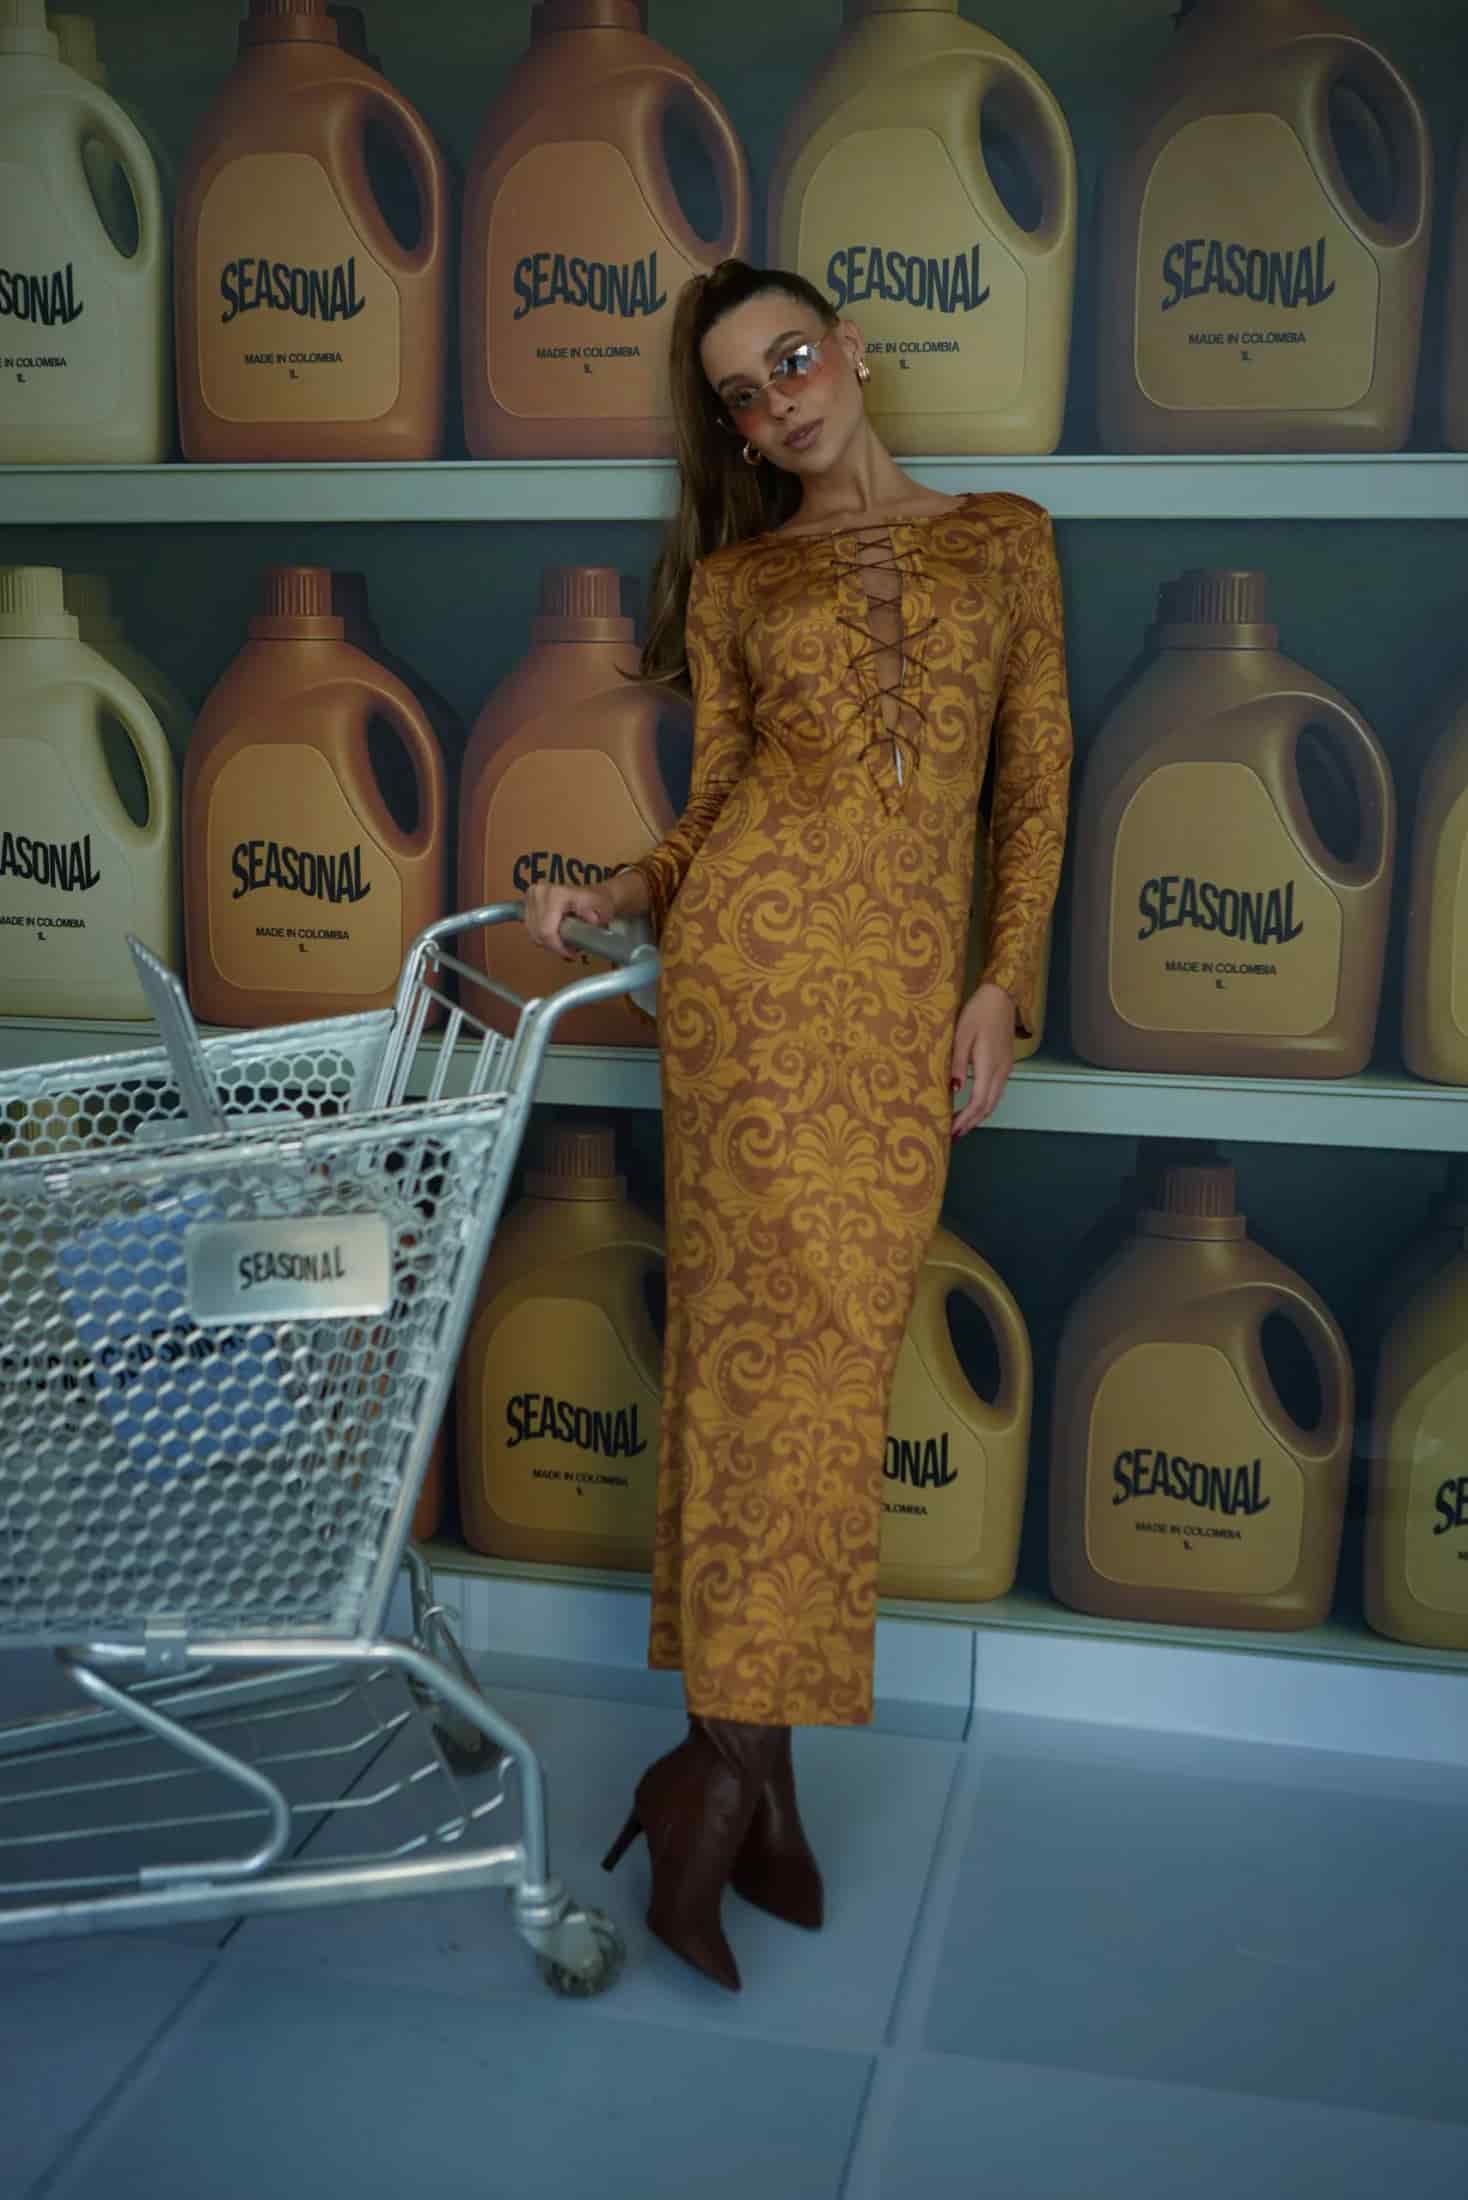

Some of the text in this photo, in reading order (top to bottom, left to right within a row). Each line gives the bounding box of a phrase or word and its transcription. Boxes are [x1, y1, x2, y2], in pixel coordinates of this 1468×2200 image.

[0, 263, 84, 325] SONAL
[221, 256, 366, 323] SEASONAL
[513, 250, 667, 320] SEASONAL
[827, 242, 990, 315] SEASONAL
[1161, 237, 1336, 312] SEASONAL
[15, 357, 67, 368] COLOMBIA
[244, 352, 343, 364] MADE IN COLOMBIA
[536, 345, 640, 359] MADE IN COLOMBIA
[864, 341, 960, 353] DE IN COLOMBIA
[1188, 331, 1306, 345] MADE IN COLOMBIA
[0, 832, 100, 892] ASONAL
[232, 840, 371, 903] SEASONAL
[26, 917, 35, 927] IN
[37, 917, 86, 929] COLOMBIA
[255, 927, 350, 940] MADE IN COLOMBIA
[1138, 876, 1304, 944] SEASONAL
[1165, 960, 1277, 976] MADE IN COLOMBIA
[238, 1245, 345, 1291] SEASONAL
[507, 1394, 648, 1458] SEASONAL
[881, 1432, 958, 1488] ONAL
[1113, 1448, 1270, 1515] SEASONAL
[1136, 1522, 1241, 1541] MADE IN COLOMBIA
